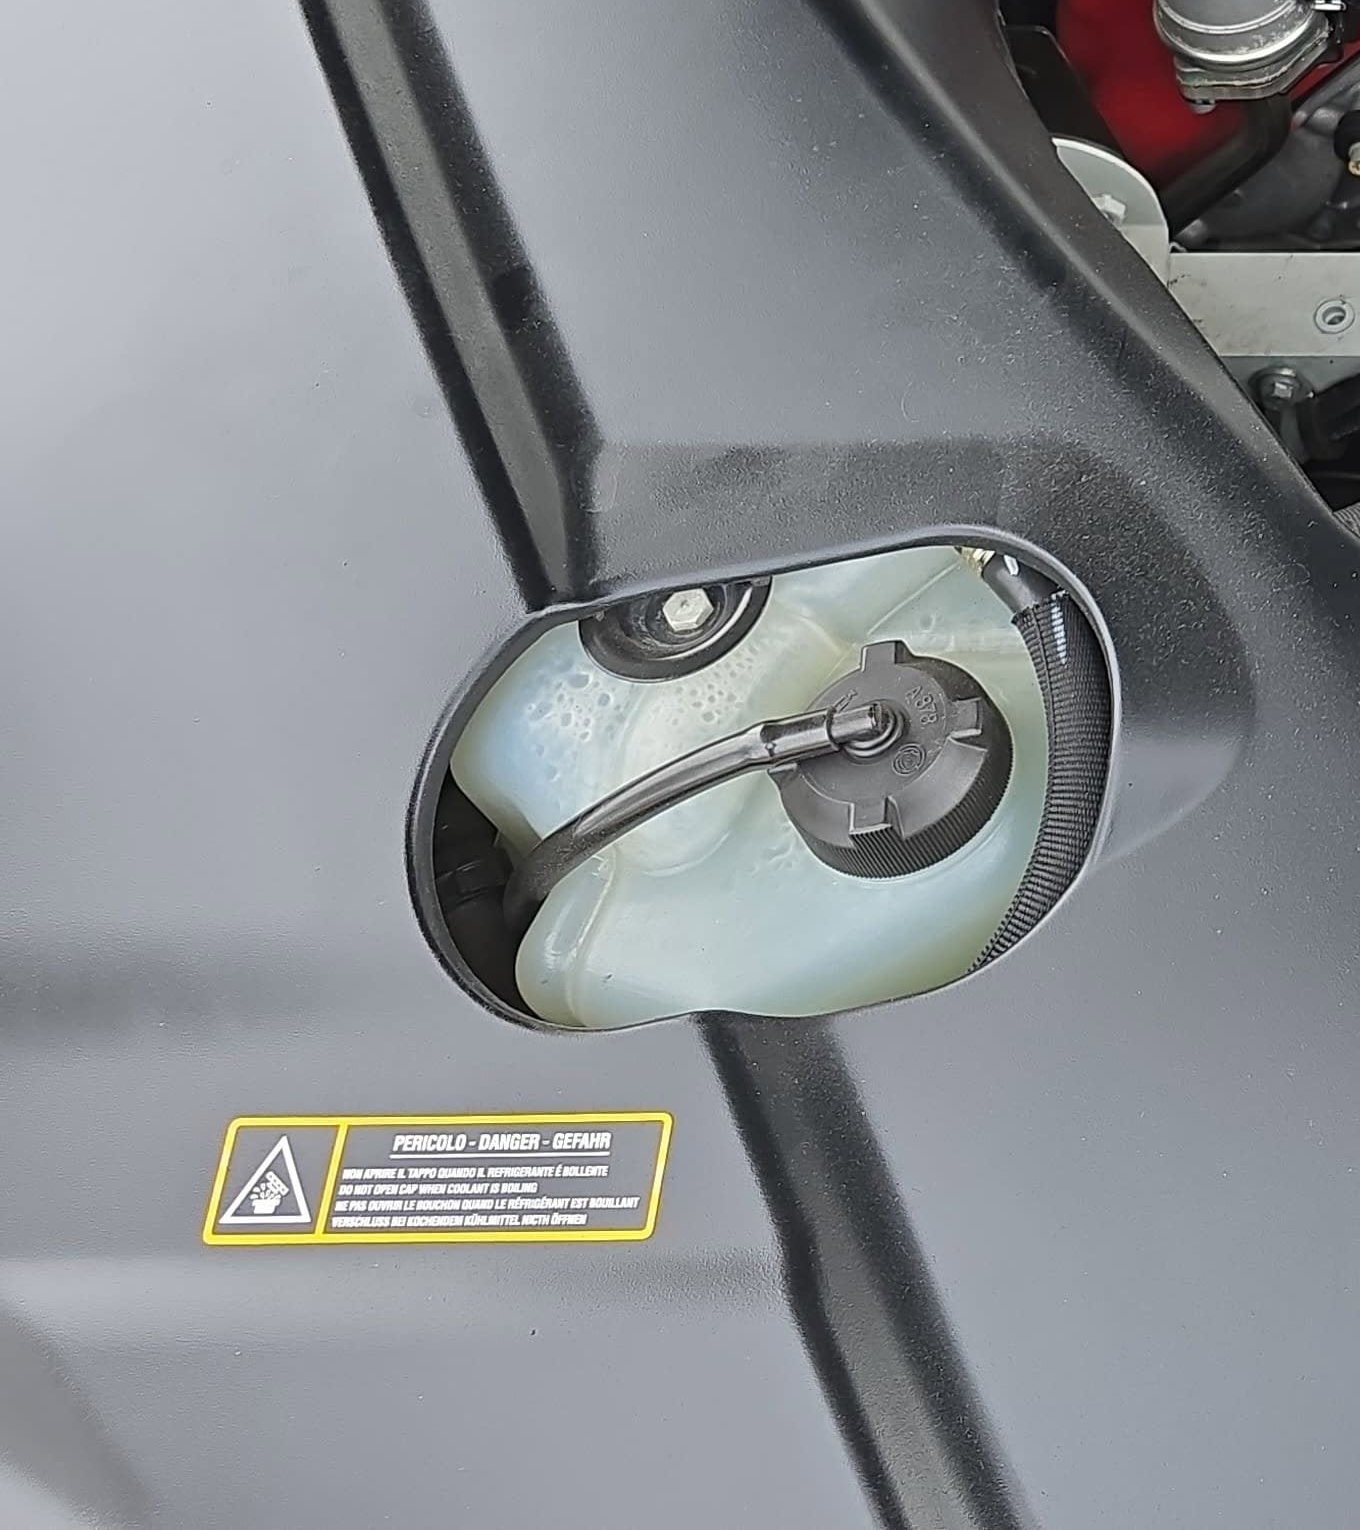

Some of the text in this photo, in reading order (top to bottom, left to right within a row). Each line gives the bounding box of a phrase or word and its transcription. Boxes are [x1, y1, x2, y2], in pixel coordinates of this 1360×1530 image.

[392, 1134, 467, 1151] PERICOLO
[478, 1133, 541, 1151] DANGER
[552, 1132, 611, 1150] GEFAHR
[407, 1167, 437, 1179] TAPPO
[437, 1167, 477, 1179] QUANDO
[338, 1182, 538, 1196] DO NOT OPEN CAP WHEN COOLANT IS BOILING
[349, 1200, 368, 1211] PAS
[403, 1200, 417, 1211] LE
[416, 1199, 461, 1210] BOUCHON
[461, 1199, 494, 1210] QUAND
[494, 1199, 507, 1209] LE
[570, 1197, 589, 1208] EST
[589, 1197, 640, 1208] BOUILLANT
